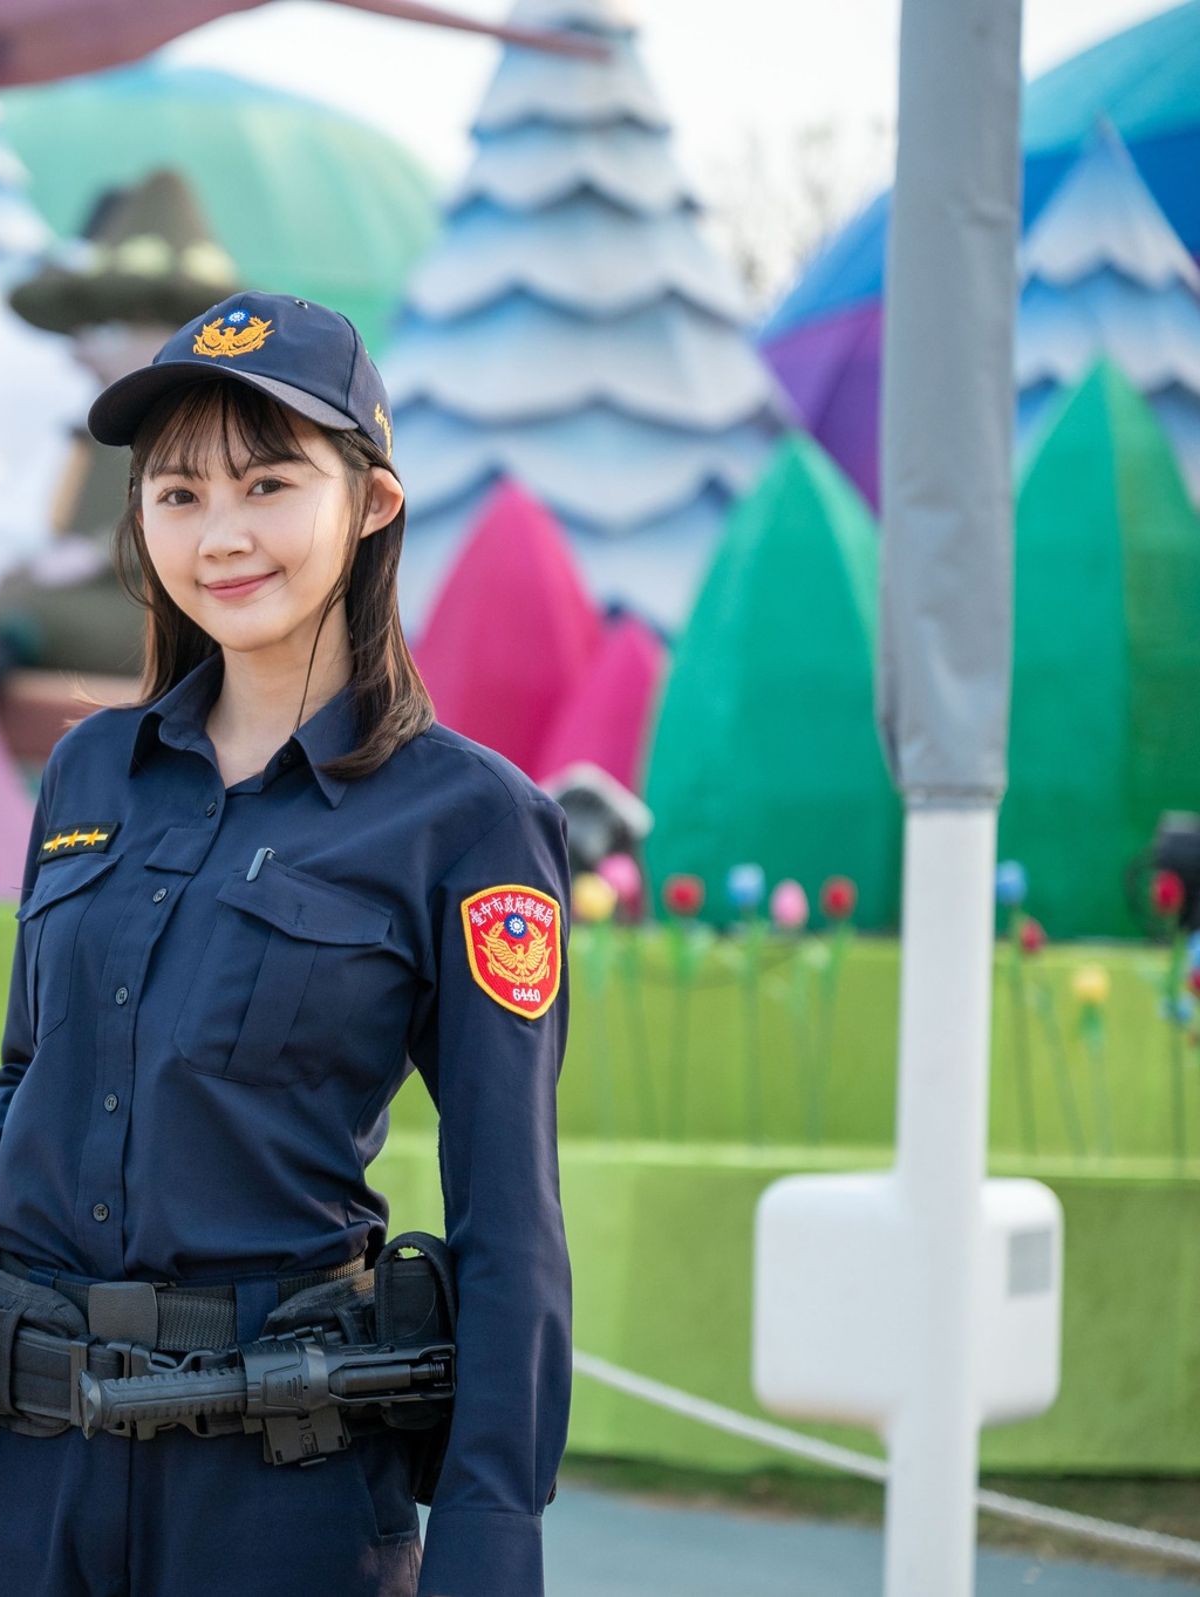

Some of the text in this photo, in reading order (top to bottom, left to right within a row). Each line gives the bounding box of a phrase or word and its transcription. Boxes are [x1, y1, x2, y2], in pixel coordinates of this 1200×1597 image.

[469, 894, 553, 927] 臺中市政府警察局
[512, 988, 541, 1003] 6440
